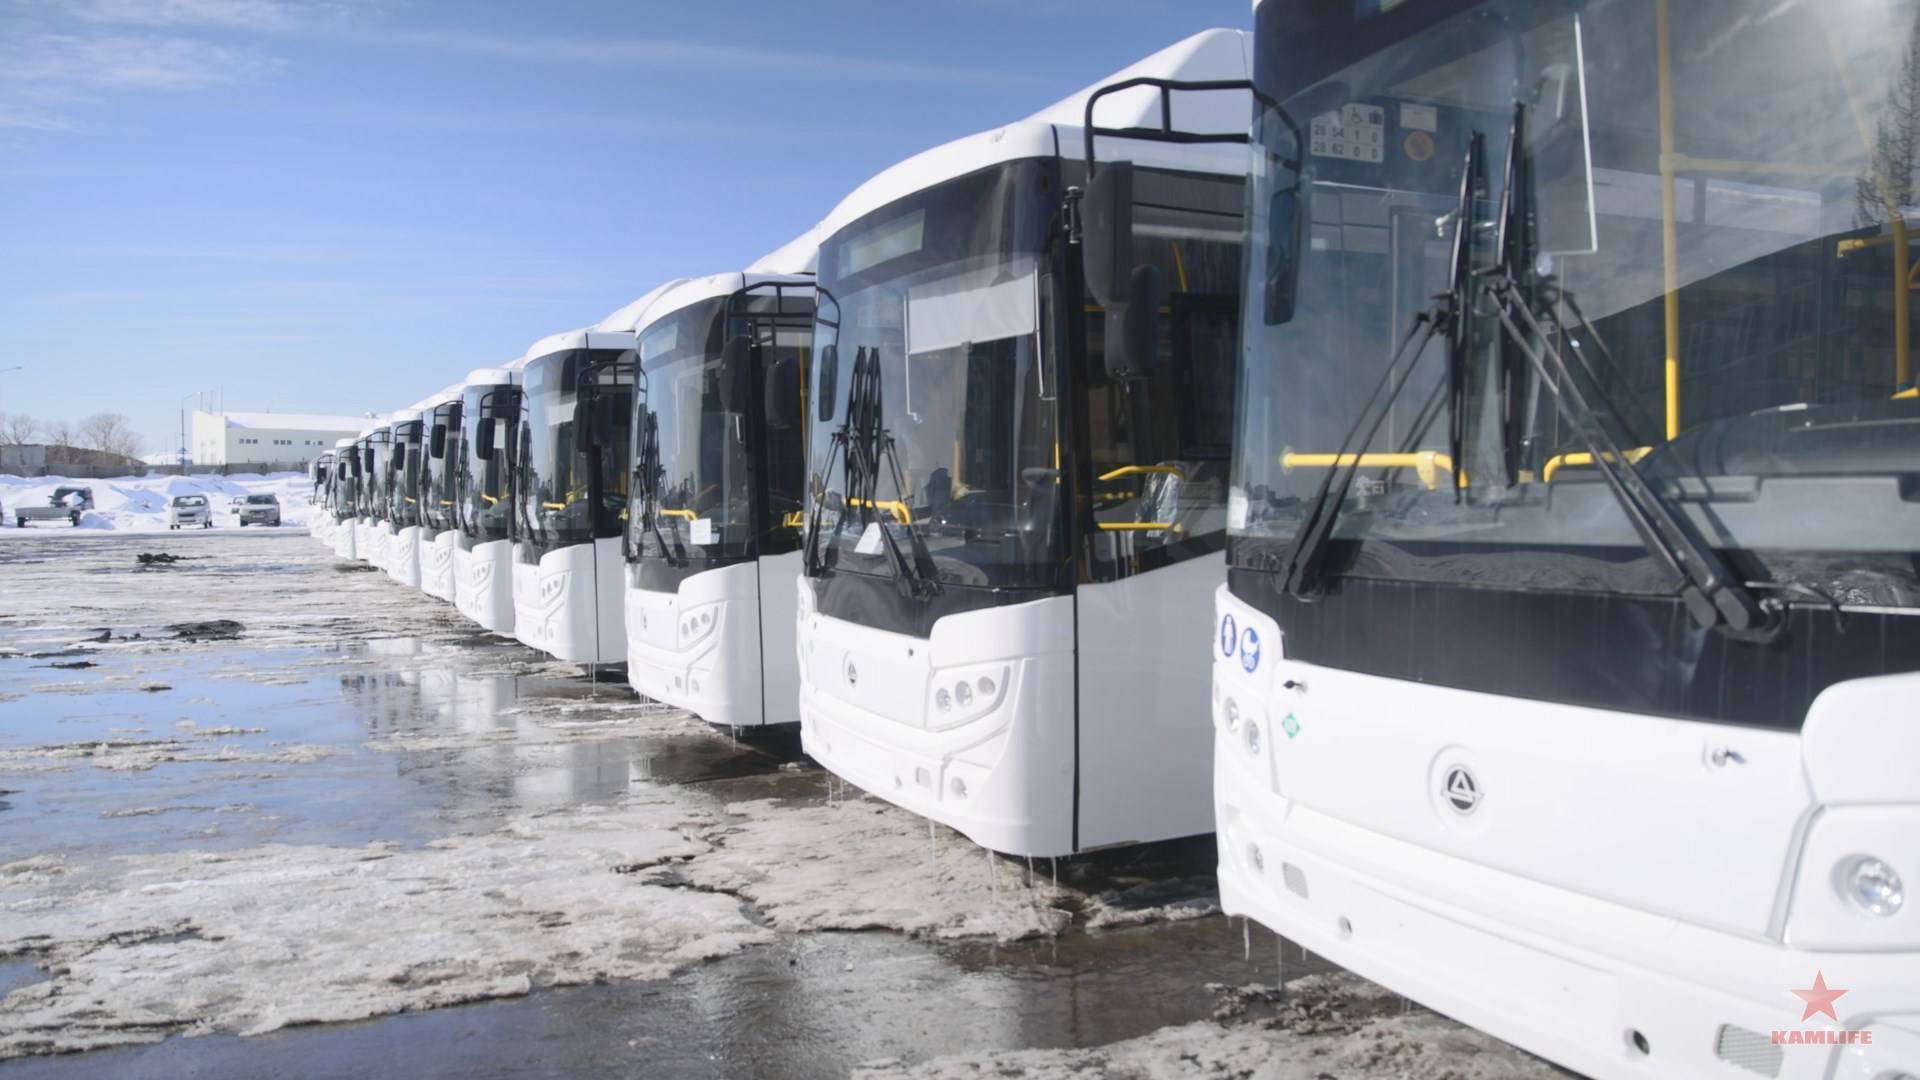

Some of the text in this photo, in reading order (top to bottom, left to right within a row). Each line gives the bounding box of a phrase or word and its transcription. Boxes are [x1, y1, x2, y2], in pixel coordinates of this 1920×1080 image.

[1371, 131, 1378, 143] 0
[1353, 146, 1360, 158] 0
[1371, 148, 1378, 160] 0
